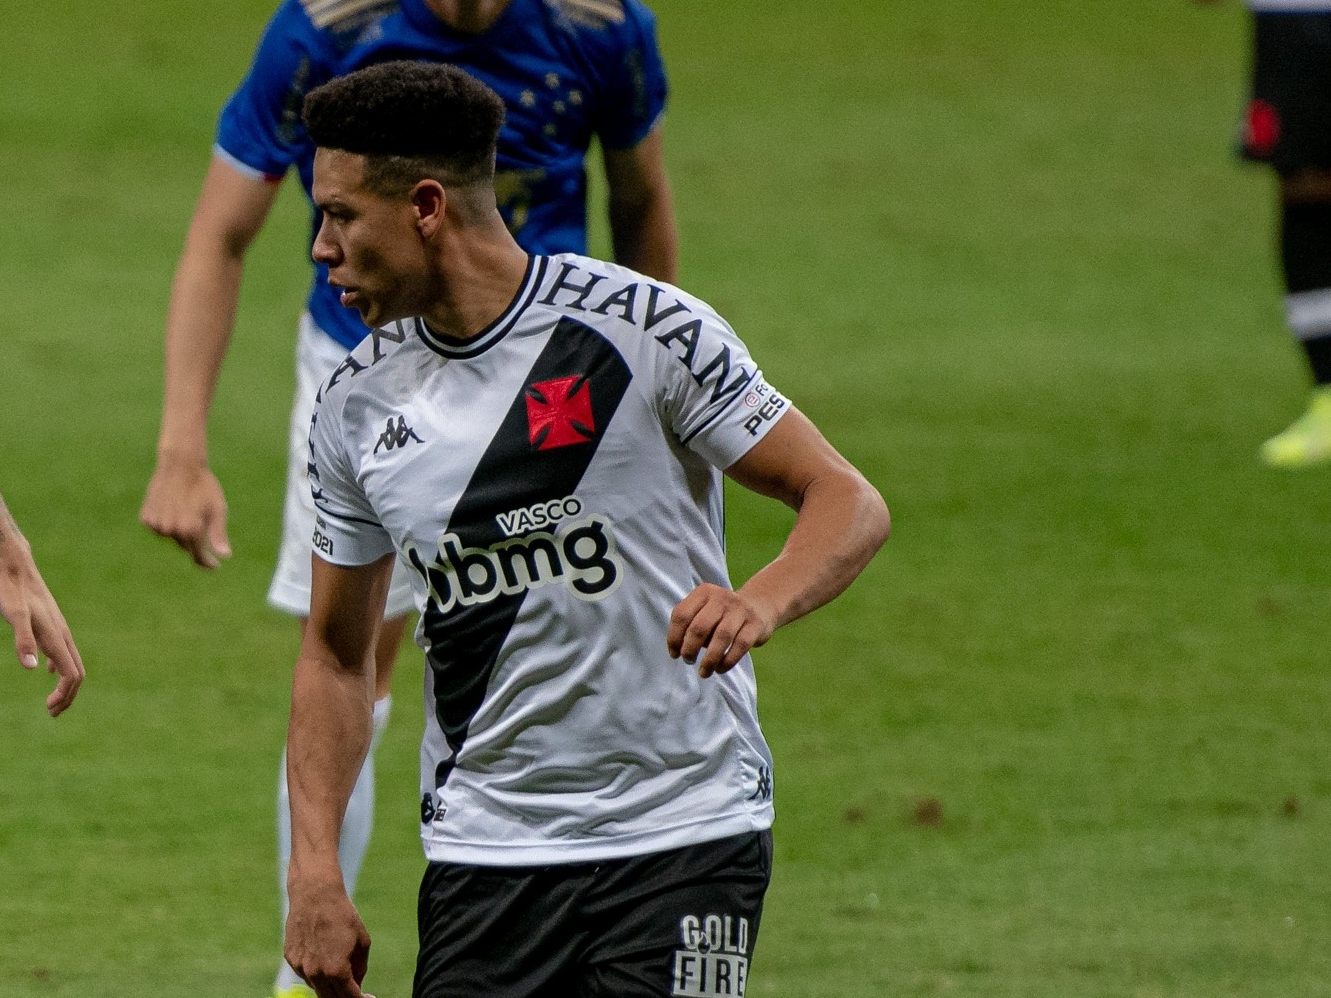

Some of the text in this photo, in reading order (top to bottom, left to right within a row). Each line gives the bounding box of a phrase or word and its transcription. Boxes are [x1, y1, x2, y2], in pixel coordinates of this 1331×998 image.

[536, 261, 751, 404] HAVAN
[744, 394, 785, 437] PES
[498, 498, 582, 533] VASCO
[681, 914, 748, 954] GOLD
[679, 956, 745, 997] FIRE
